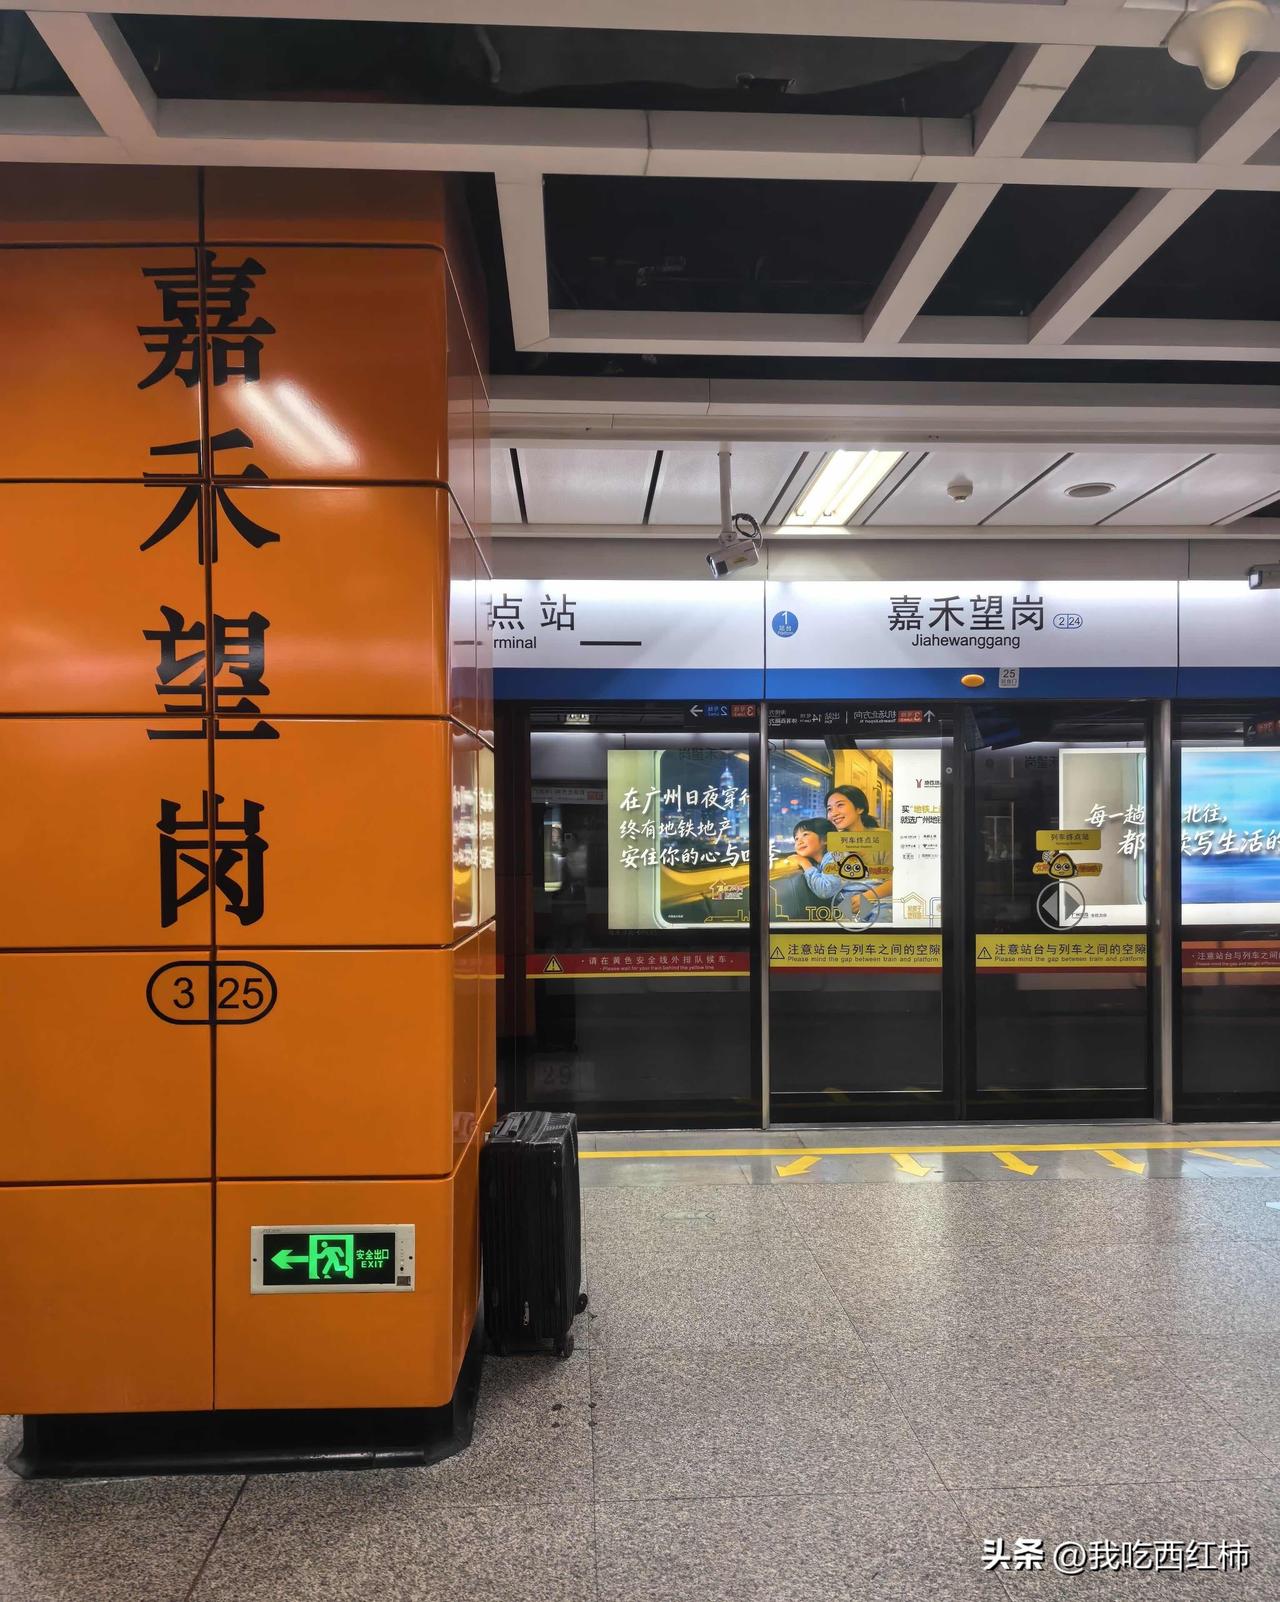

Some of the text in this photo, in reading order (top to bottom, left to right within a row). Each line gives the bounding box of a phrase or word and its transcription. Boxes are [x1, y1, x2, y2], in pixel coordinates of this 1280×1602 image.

[137, 247, 280, 928] 嘉禾望岗
[781, 611, 788, 625] 1
[888, 595, 1043, 631] 嘉禾望岗
[1058, 617, 1081, 626] 2 24
[493, 636, 537, 649] rminal
[911, 634, 1021, 650] Jiahewanggang
[1003, 669, 1016, 678] 25
[620, 817, 732, 845] 终有地铁地产
[787, 943, 941, 956] 注意站台与列车之间的空隙
[994, 943, 1147, 956] 注意站台与列车之间的空隙
[1197, 951, 1280, 961] 注意站台与列车之间
[173, 977, 264, 1009] 3 25
[355, 1248, 390, 1260] 安全出口
[361, 1260, 384, 1269] EXIT
